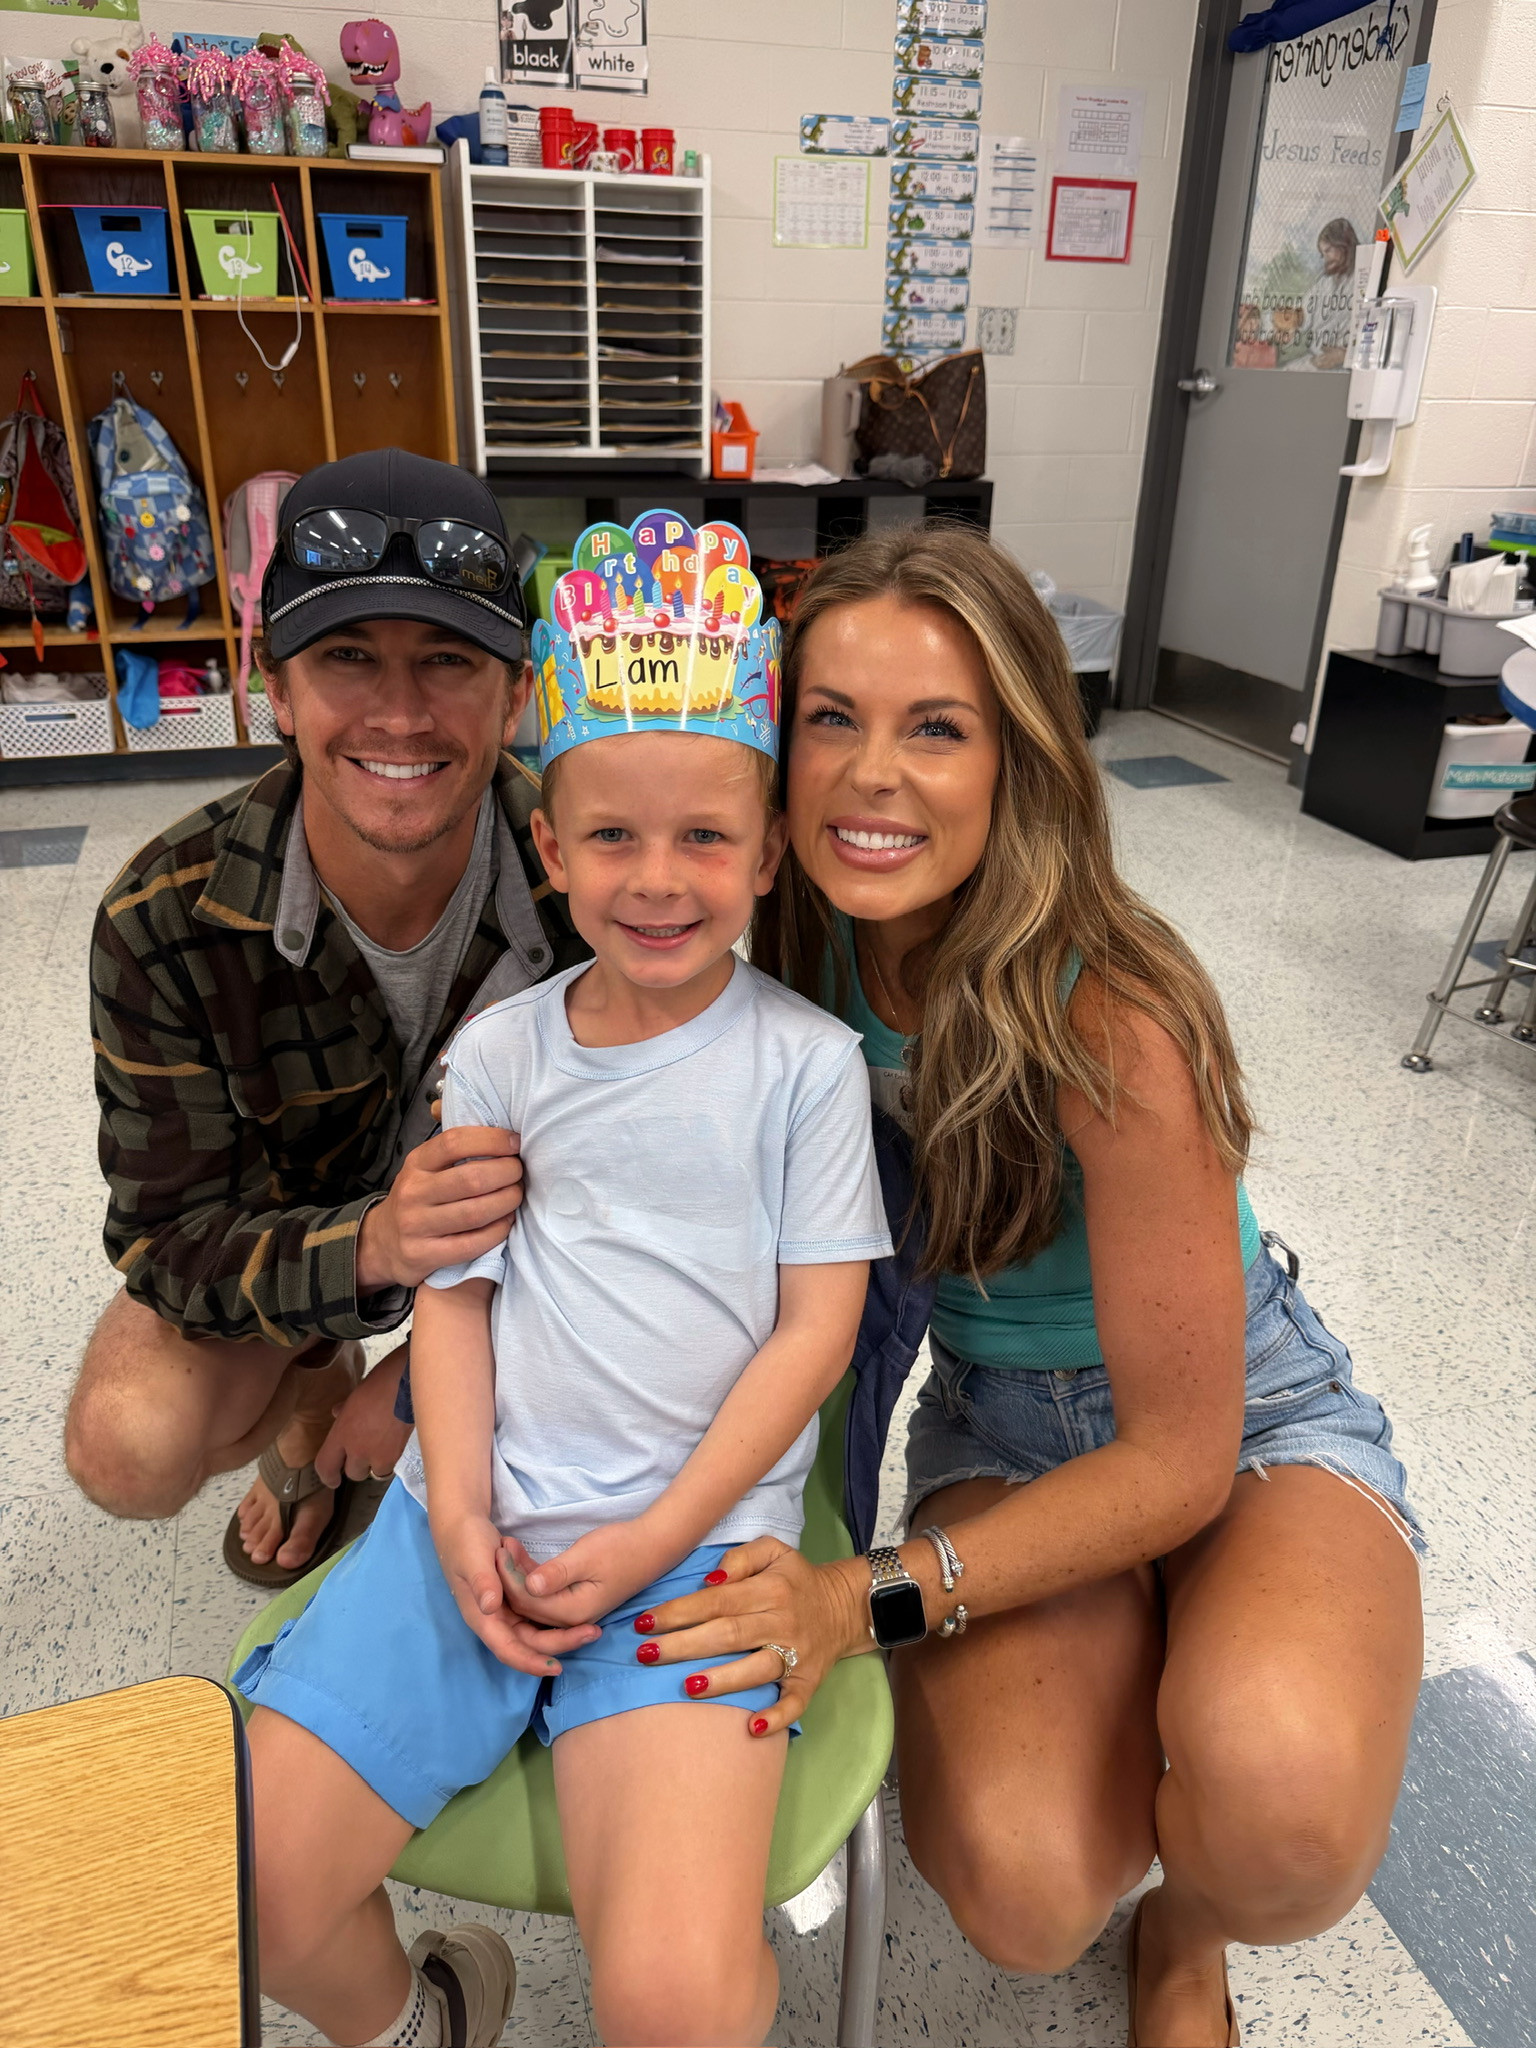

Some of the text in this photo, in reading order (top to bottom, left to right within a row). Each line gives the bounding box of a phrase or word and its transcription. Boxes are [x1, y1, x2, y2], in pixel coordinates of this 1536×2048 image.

[512, 44, 560, 68] black
[588, 50, 635, 72] white
[14, 66, 28, 79] YOU
[28, 62, 46, 74] GIVE
[942, 61, 968, 71] Lunch
[920, 86, 938, 98] 11:15
[948, 89, 968, 100] 11:20
[1262, 128, 1382, 166] Jesus Feeds
[120, 256, 134, 270] 12
[231, 260, 243, 273] 13
[360, 262, 372, 275] 14
[591, 520, 740, 559] Happy
[558, 548, 760, 611] Birthday
[596, 656, 679, 690] Lam
